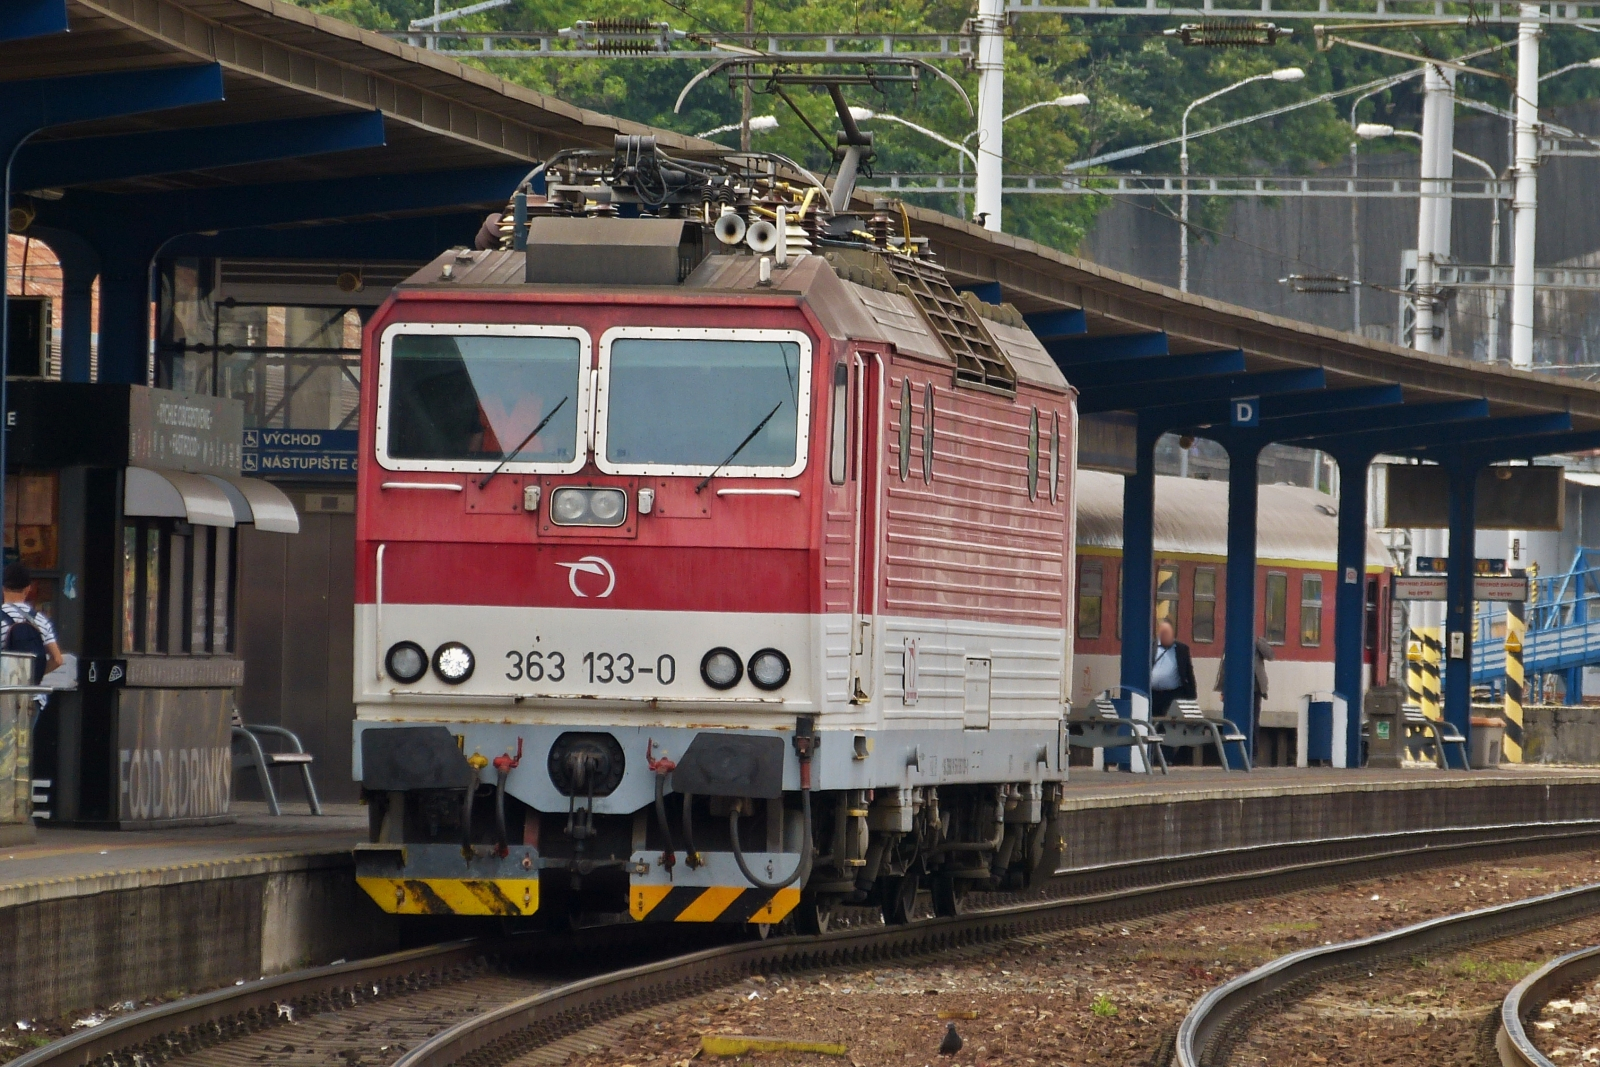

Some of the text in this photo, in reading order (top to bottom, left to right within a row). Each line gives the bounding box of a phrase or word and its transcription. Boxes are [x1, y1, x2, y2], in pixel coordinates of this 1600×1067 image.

[1236, 403, 1252, 421] D
[262, 430, 321, 446] VÝCHOD
[262, 453, 348, 470] NÁSTUPIŠTE
[505, 650, 676, 685] 363 133-0
[119, 748, 163, 820] FOOD
[179, 746, 232, 817] DRINKS
